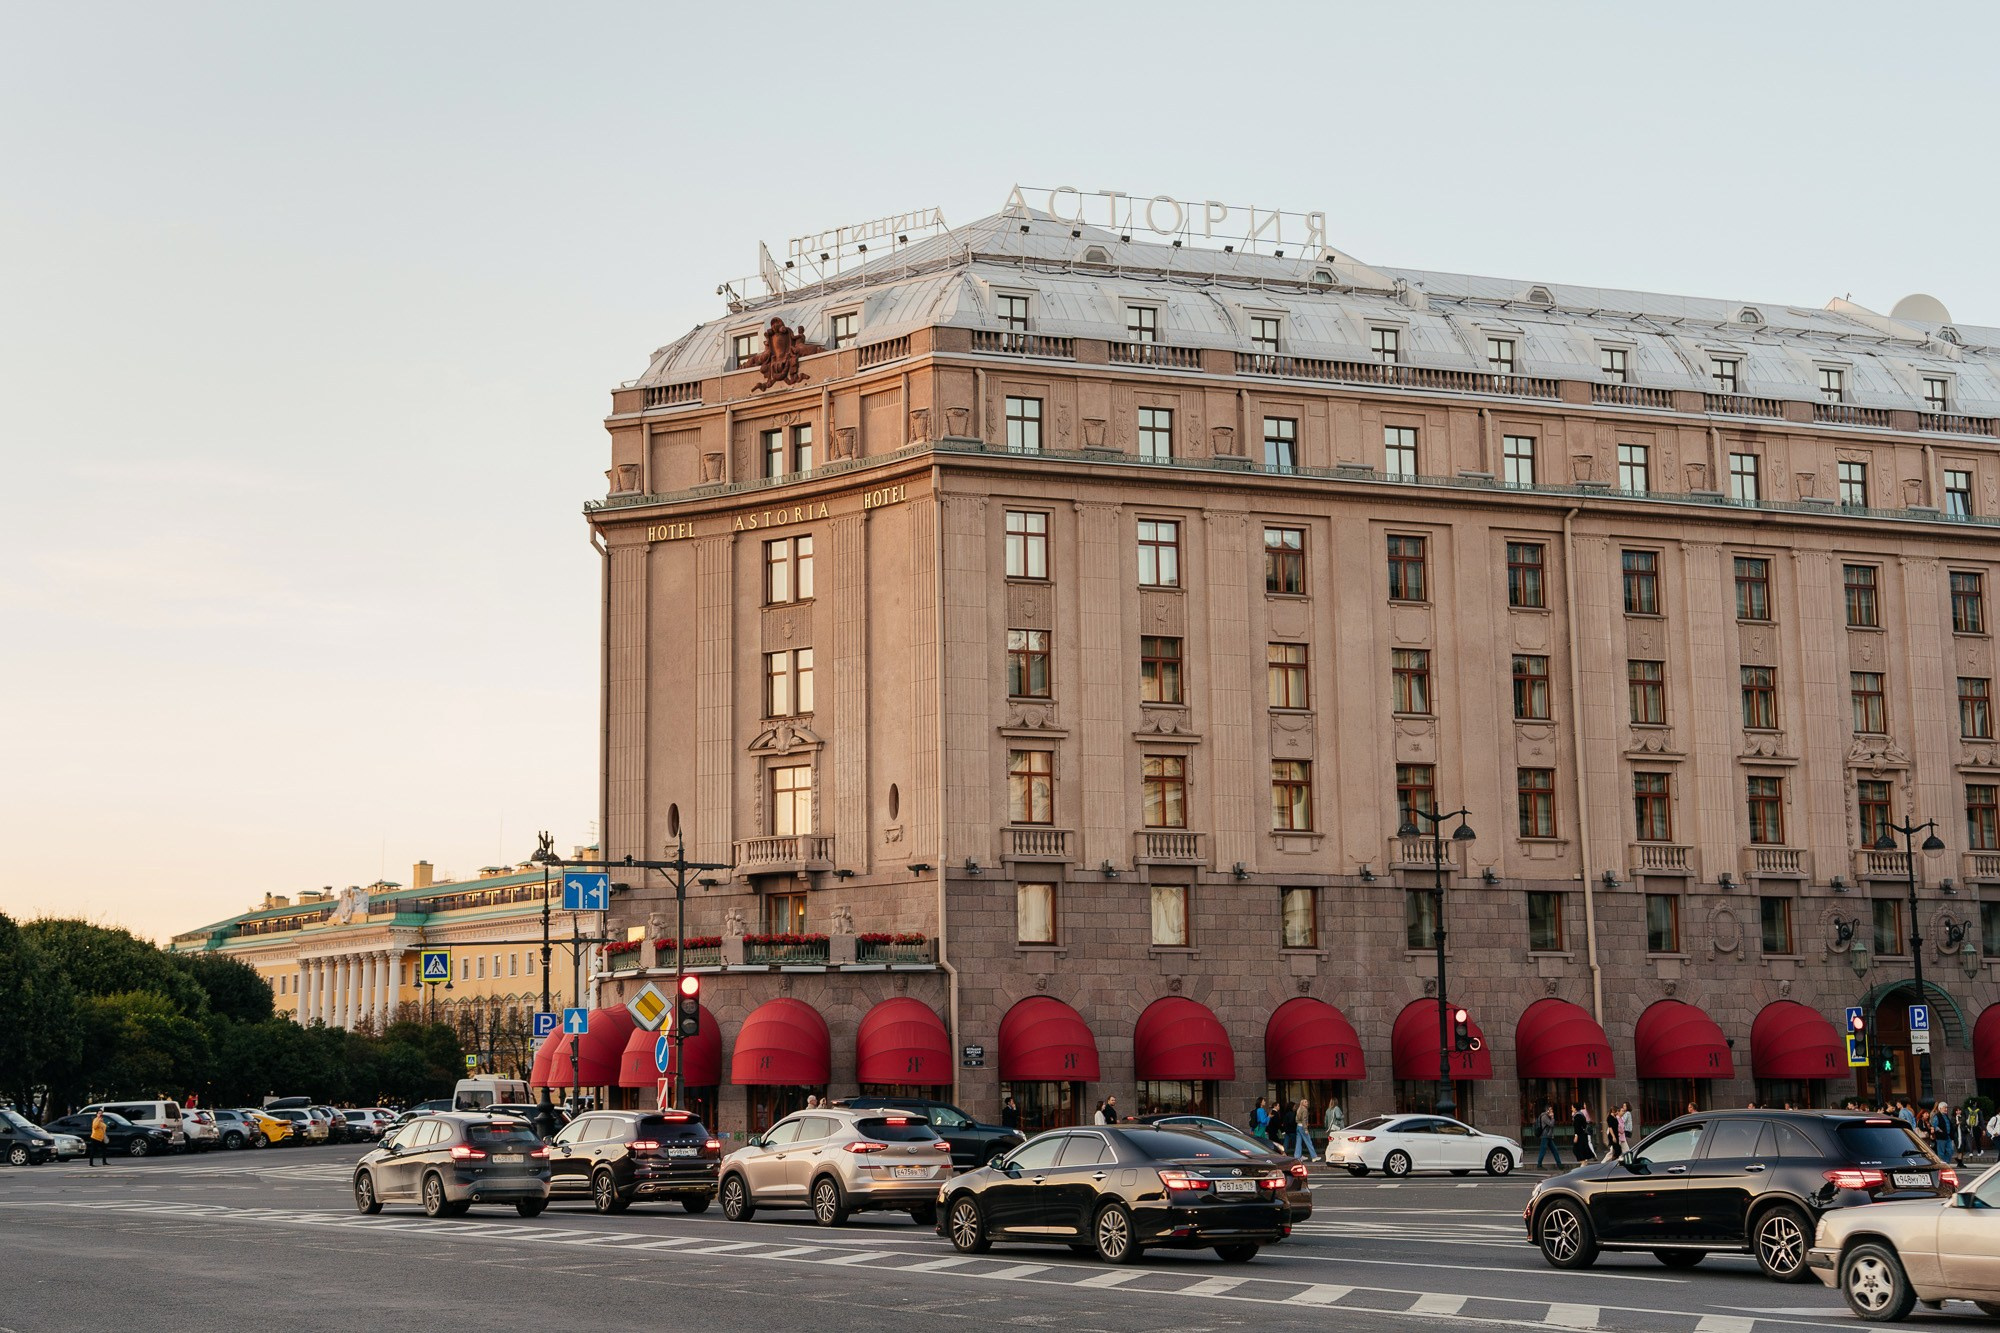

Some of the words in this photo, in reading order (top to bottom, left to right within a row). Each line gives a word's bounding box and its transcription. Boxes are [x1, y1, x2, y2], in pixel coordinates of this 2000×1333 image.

[999, 183, 1327, 250] АСТОРИЯ
[788, 205, 946, 258] ГОСТИНИЦА
[864, 484, 907, 509] HOTEL
[735, 502, 829, 531] ASTORIA
[648, 522, 695, 542] HOTEL
